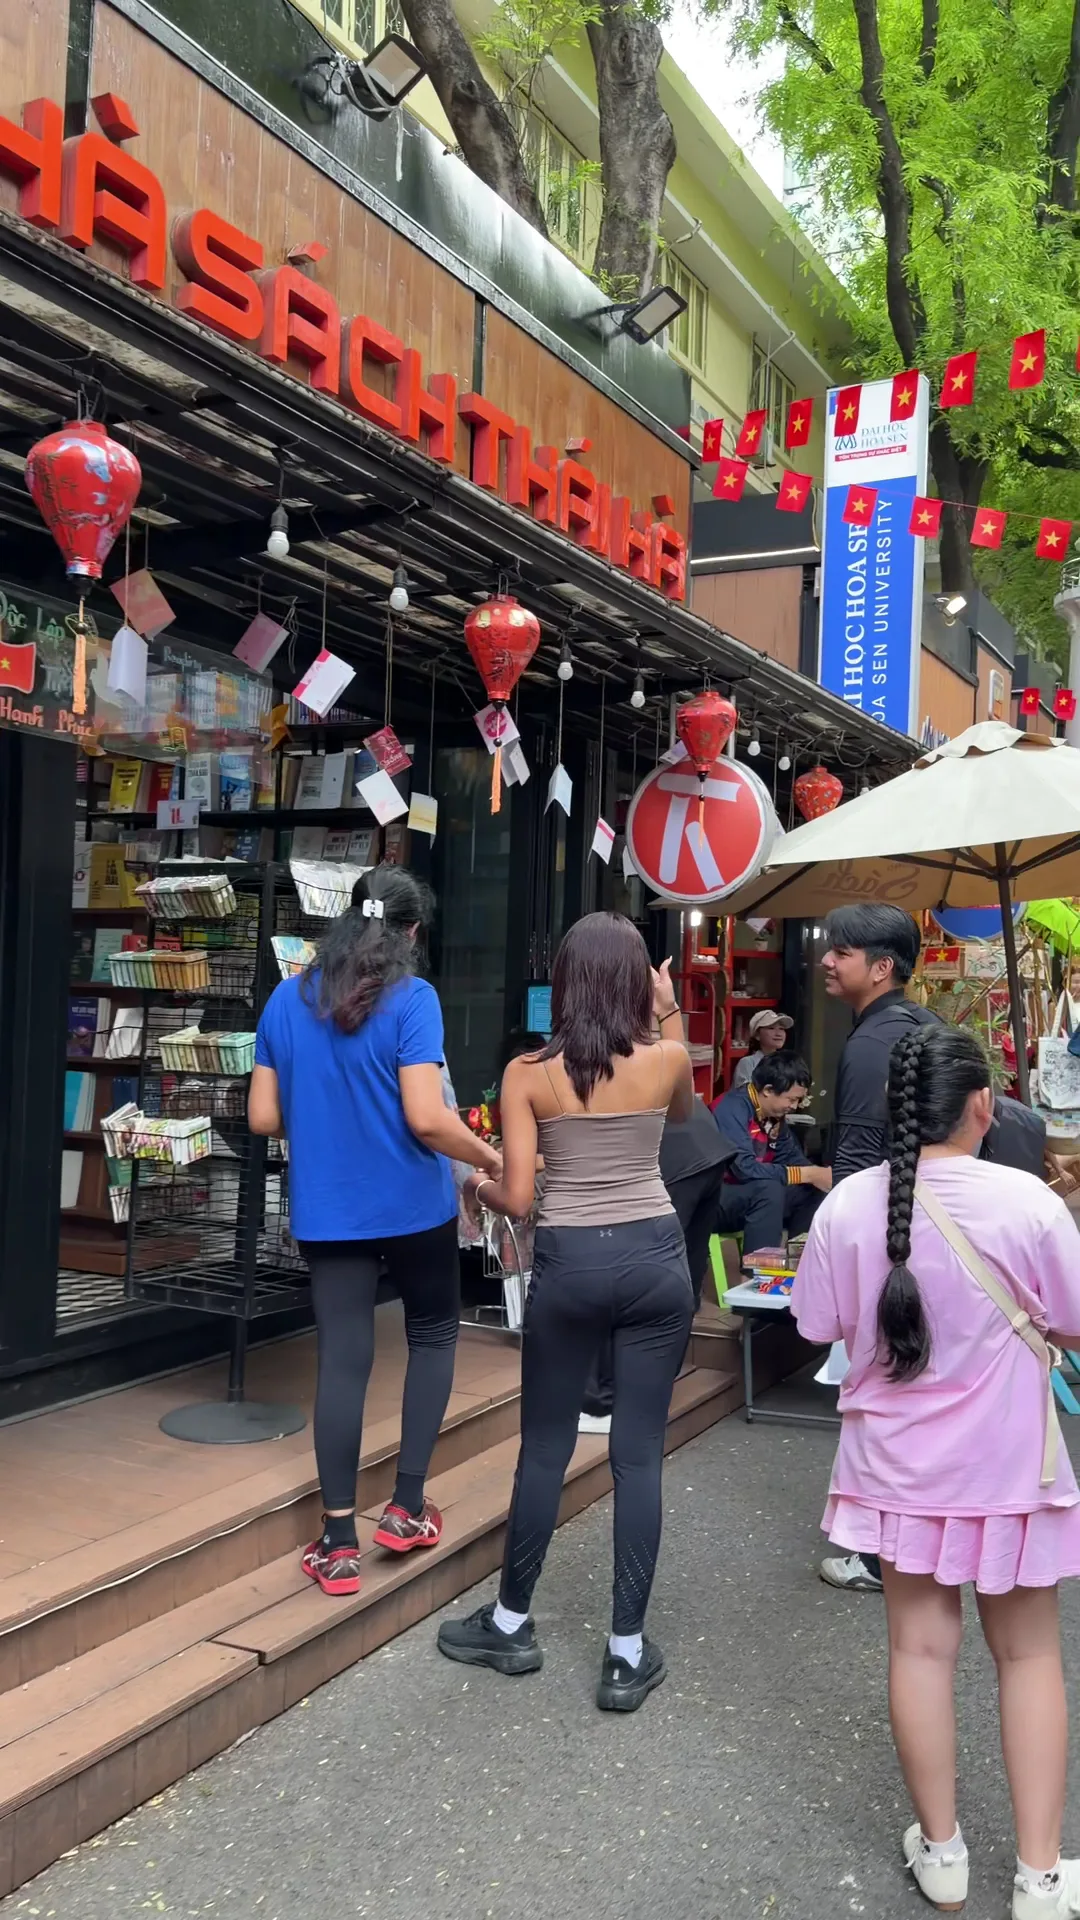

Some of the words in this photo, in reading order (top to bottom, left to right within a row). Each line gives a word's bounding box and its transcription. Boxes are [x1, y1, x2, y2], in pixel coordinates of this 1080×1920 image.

[172, 208, 456, 464] SÁCH
[458, 392, 611, 557] THÁI
[610, 495, 686, 601] HÀ
[848, 522, 868, 552] SE
[846, 561, 868, 618] HOA
[873, 499, 893, 633] UNIVERSITY
[843, 623, 866, 688] HỌC
[872, 644, 888, 685] SEN
[0, 696, 44, 728] Hạnh
[871, 695, 886, 722] OA
